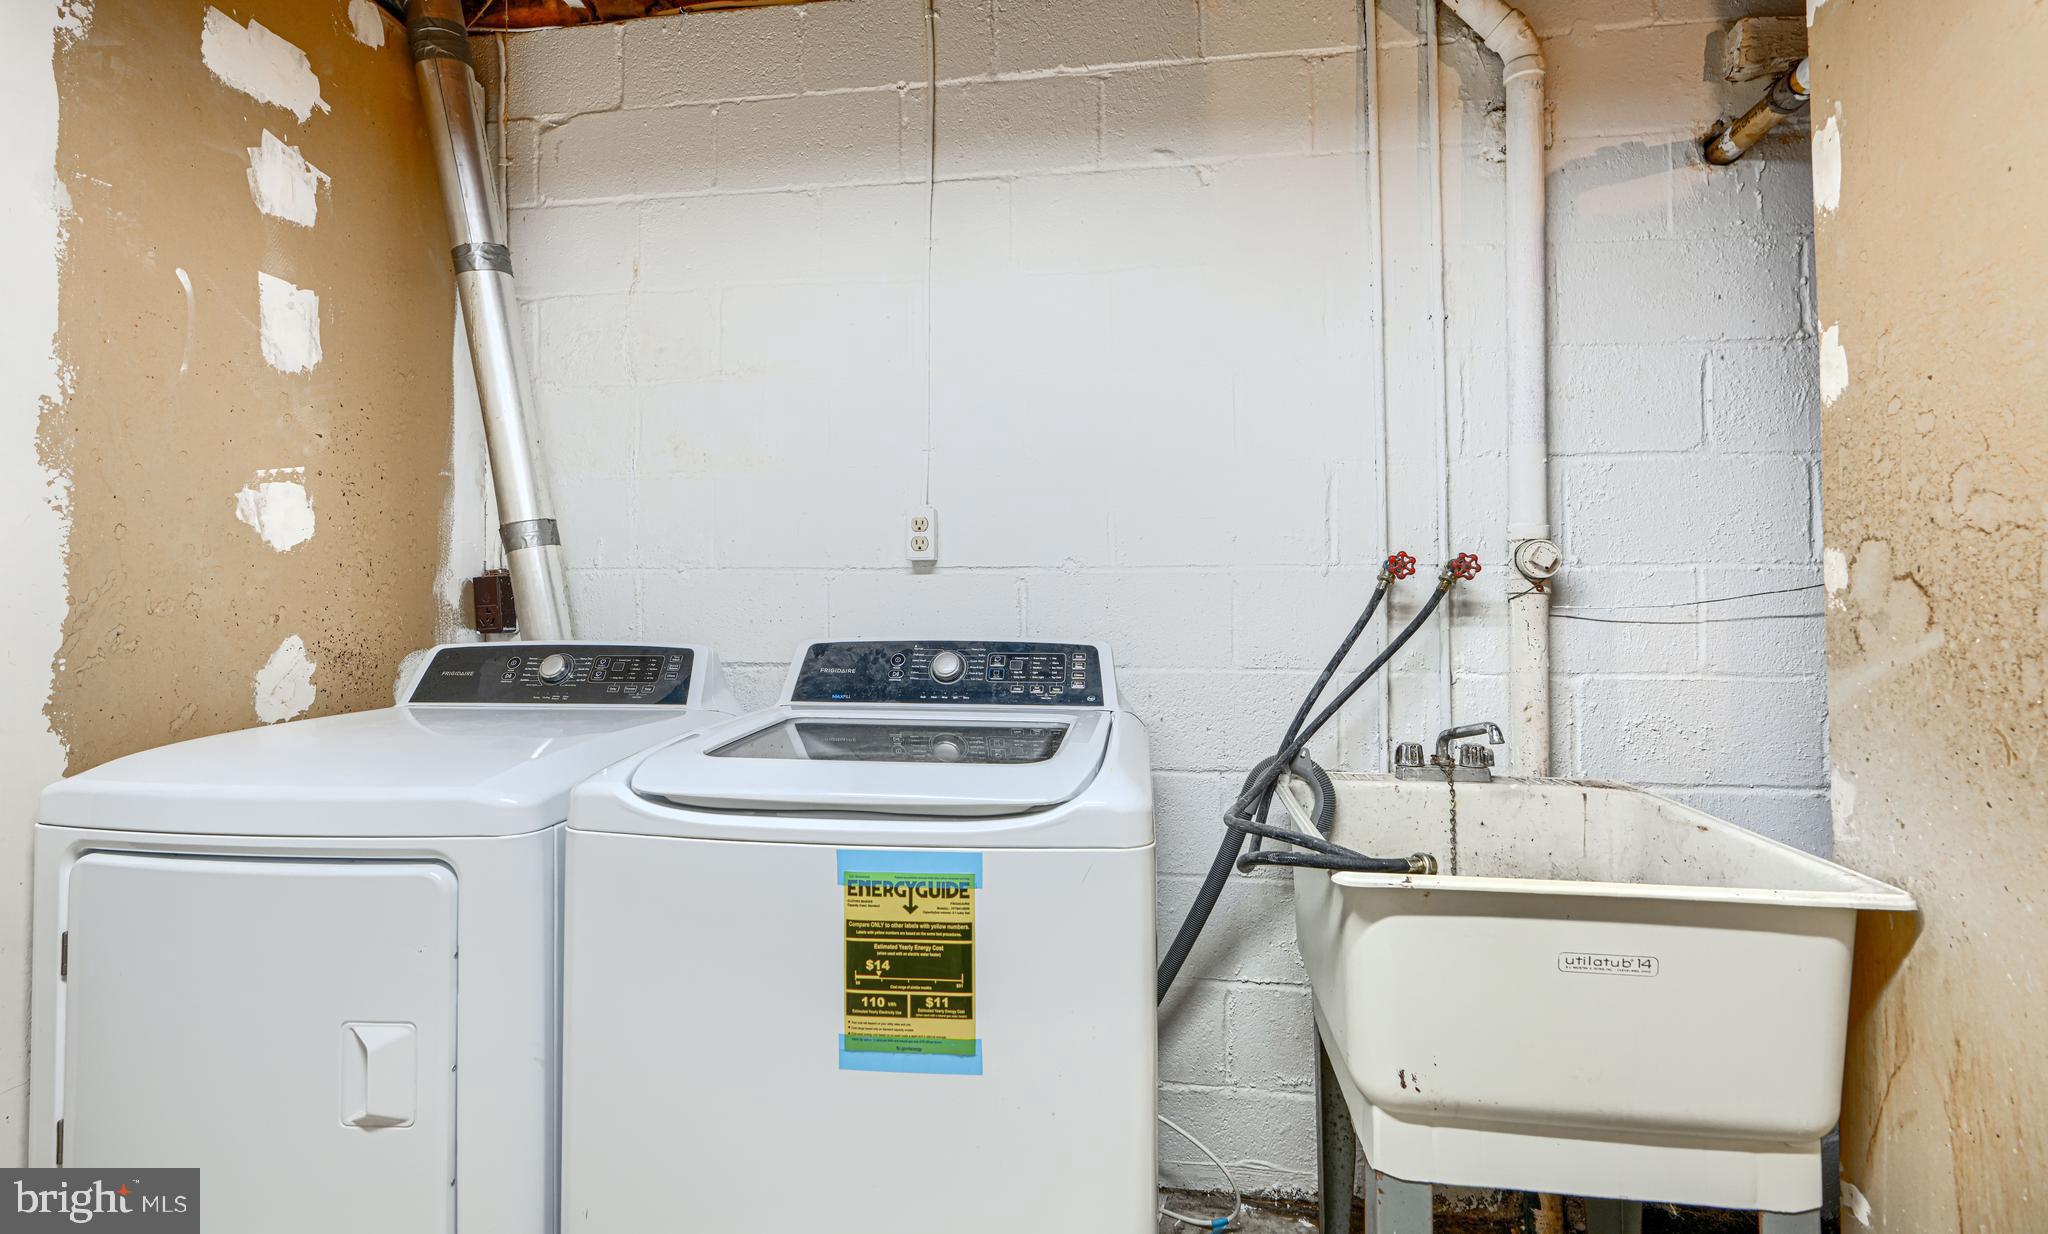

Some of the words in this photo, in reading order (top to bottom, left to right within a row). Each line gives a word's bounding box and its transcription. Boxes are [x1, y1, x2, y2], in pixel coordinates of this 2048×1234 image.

[847, 879, 970, 899] ENERGYGUIDE
[848, 920, 870, 929] Compare
[914, 944, 931, 952] Energy
[865, 959, 890, 971] $14
[1637, 959, 1652, 969] 14
[862, 996, 885, 1007] 110
[926, 996, 949, 1008] $11
